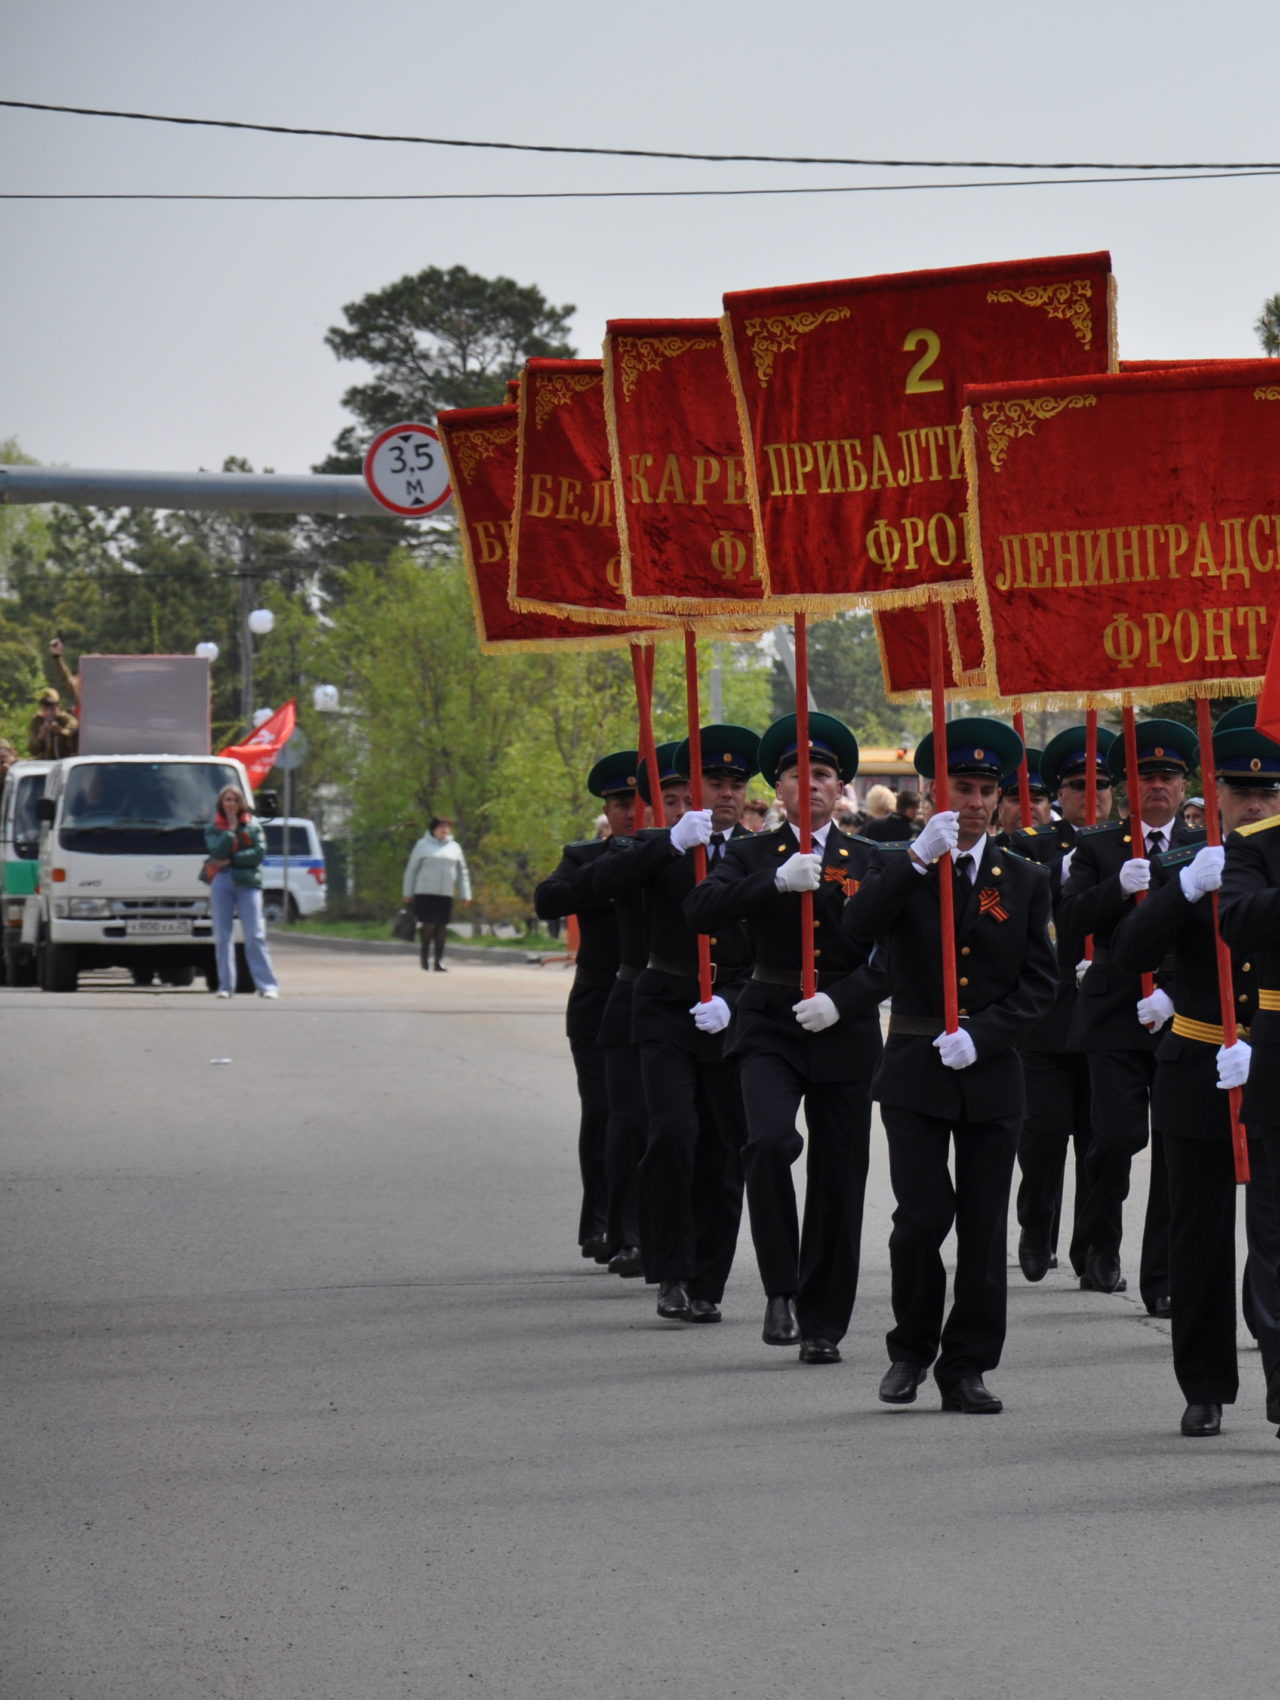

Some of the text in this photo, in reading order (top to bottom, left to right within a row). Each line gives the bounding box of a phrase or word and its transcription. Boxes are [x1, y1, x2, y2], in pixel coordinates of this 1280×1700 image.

[903, 328, 945, 394] 2
[629, 453, 751, 505] КАРЕ
[763, 424, 968, 496] ПРИБАЛТИ
[527, 473, 613, 527] БЕЛ
[1103, 605, 1268, 669] ФРОНТ
